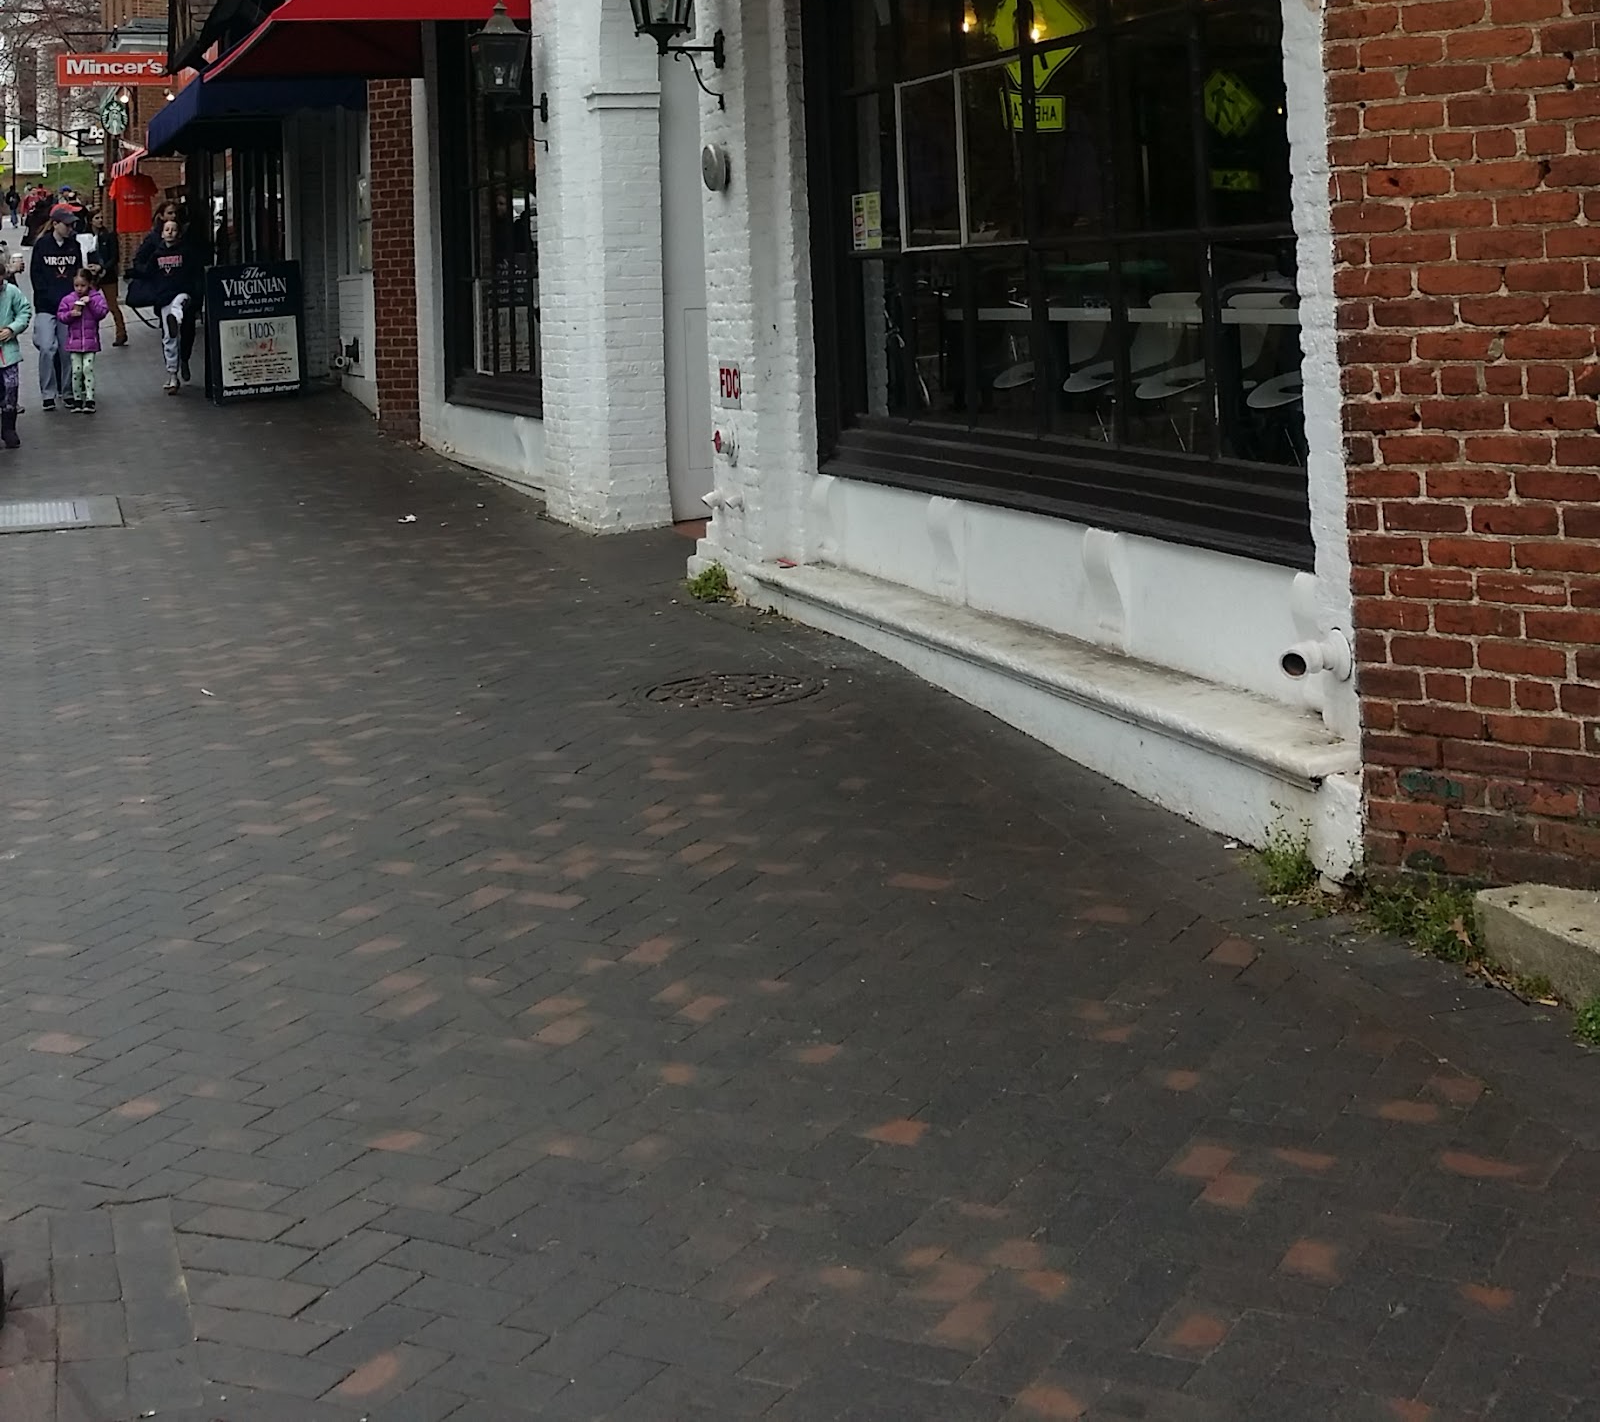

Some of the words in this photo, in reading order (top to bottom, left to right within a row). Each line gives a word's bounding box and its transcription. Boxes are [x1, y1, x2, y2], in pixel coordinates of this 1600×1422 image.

[66, 58, 163, 75] Mincer's
[240, 266, 266, 280] The
[221, 276, 287, 300] VIRGINIAN
[223, 296, 286, 307] RESTAURANT
[719, 368, 739, 400] FDC
